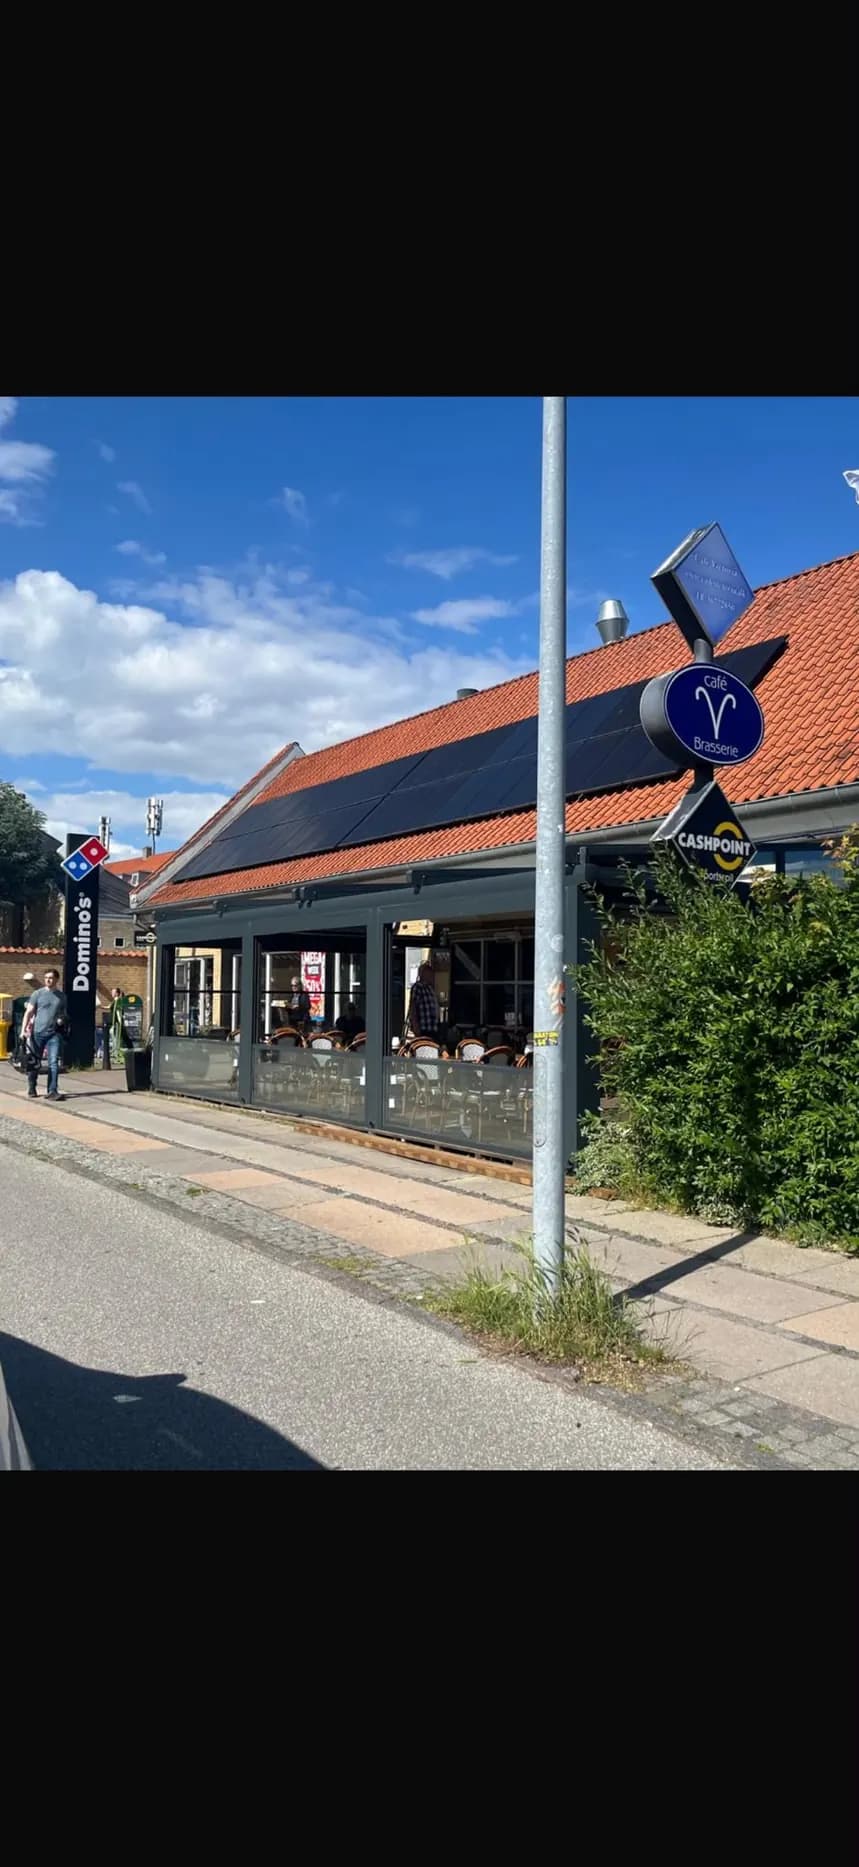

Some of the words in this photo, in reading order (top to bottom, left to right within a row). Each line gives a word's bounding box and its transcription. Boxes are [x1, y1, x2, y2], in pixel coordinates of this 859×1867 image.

[694, 736, 739, 758] Brasserie
[678, 833, 751, 856] CASHPOINT
[73, 897, 92, 991] Domino's
